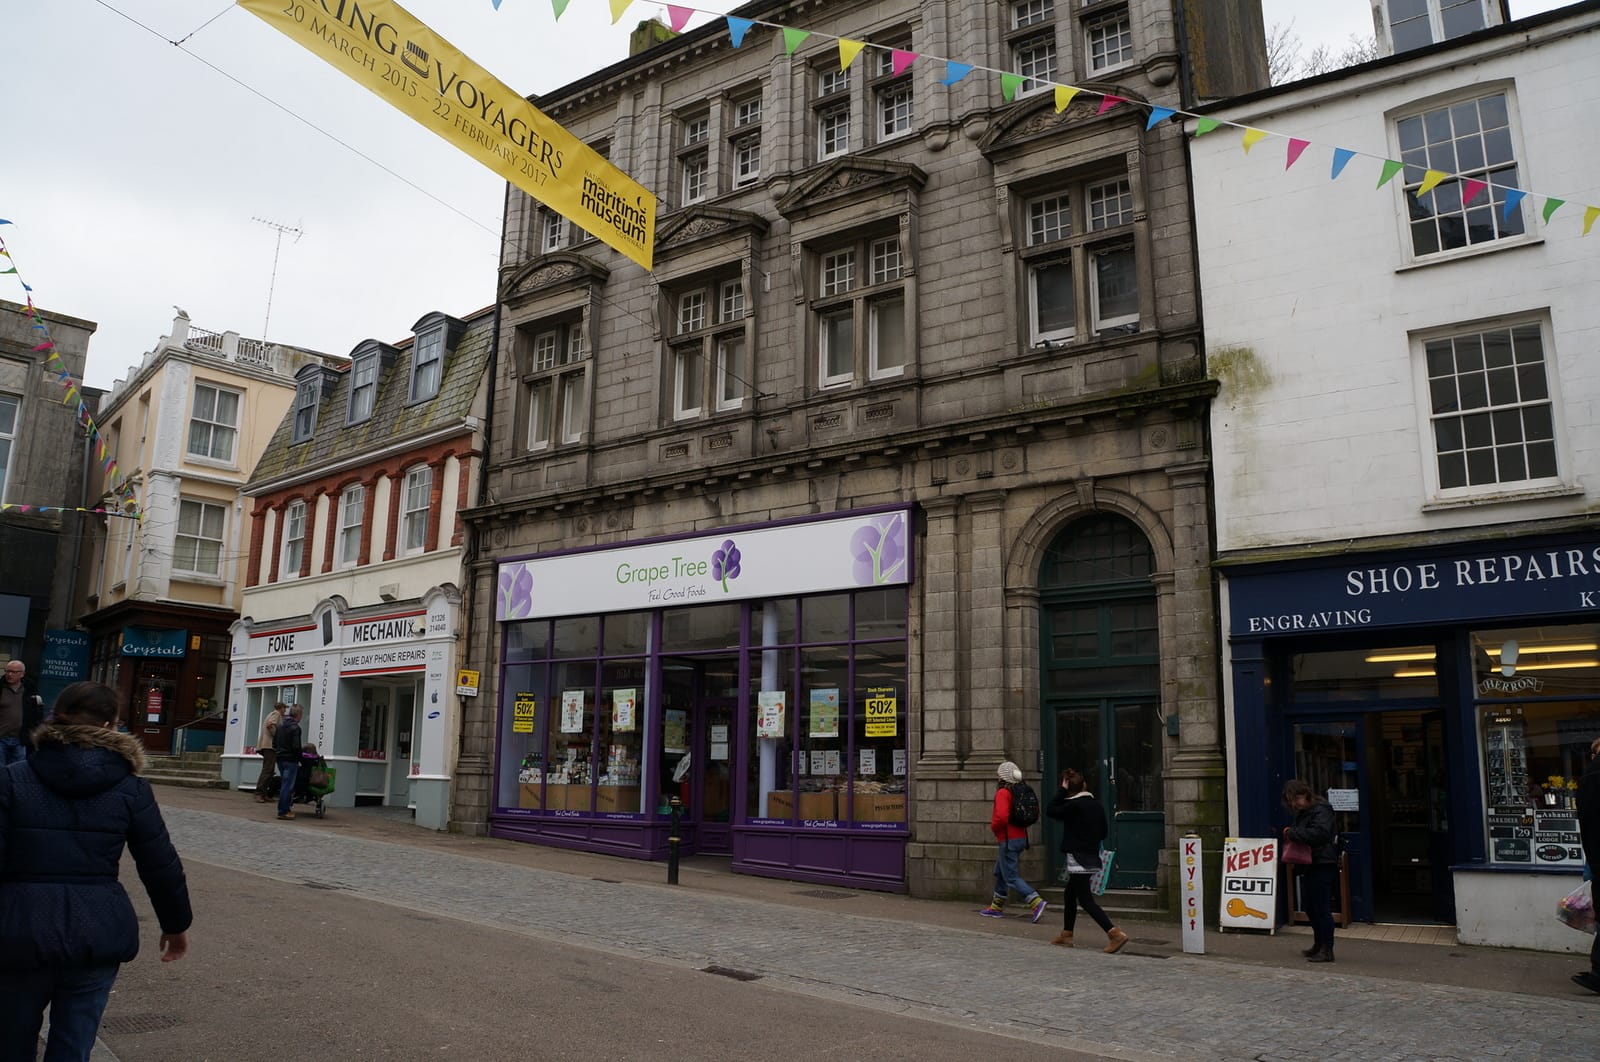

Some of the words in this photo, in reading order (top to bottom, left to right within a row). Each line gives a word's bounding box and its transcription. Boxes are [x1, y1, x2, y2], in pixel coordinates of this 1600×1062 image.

[284, 0, 305, 23] 20
[310, 16, 376, 72] MARCH
[381, 63, 418, 97] 2015
[432, 97, 451, 121] 22
[454, 114, 518, 166] FEBRUARY
[520, 158, 548, 187] 2017
[434, 57, 564, 179] VOYAGERS
[583, 177, 647, 230] maritime
[580, 191, 646, 244] museum
[616, 562, 669, 586] Grape
[672, 557, 708, 578] Tree
[1346, 563, 1441, 596] SHOE
[648, 589, 661, 602] Feel
[663, 586, 686, 601] Good
[687, 585, 707, 600] Foods
[1579, 590, 1600, 608] K
[1249, 608, 1372, 632] ENGRAVING
[353, 619, 415, 643] MECHANIX
[122, 643, 185, 656] Crystals
[268, 634, 295, 653] FONE
[256, 665, 264, 674] WE
[265, 664, 276, 673] BUY
[276, 663, 287, 673] ANY
[287, 661, 305, 671] PHONE
[343, 656, 359, 666] SAME
[361, 655, 374, 665] DAY
[375, 652, 396, 664] PHONE
[397, 649, 426, 661] REPAIRS
[321, 660, 329, 706] PHONE
[1485, 678, 1535, 692] HERRON
[516, 702, 533, 714] 50%
[868, 700, 893, 714] 50%
[1518, 829, 1530, 837] 29
[1226, 843, 1274, 874] KEYS
[1572, 849, 1578, 857] 3
[1185, 842, 1196, 890] Keys
[1228, 879, 1270, 892] CUT
[1187, 897, 1196, 930] cut
